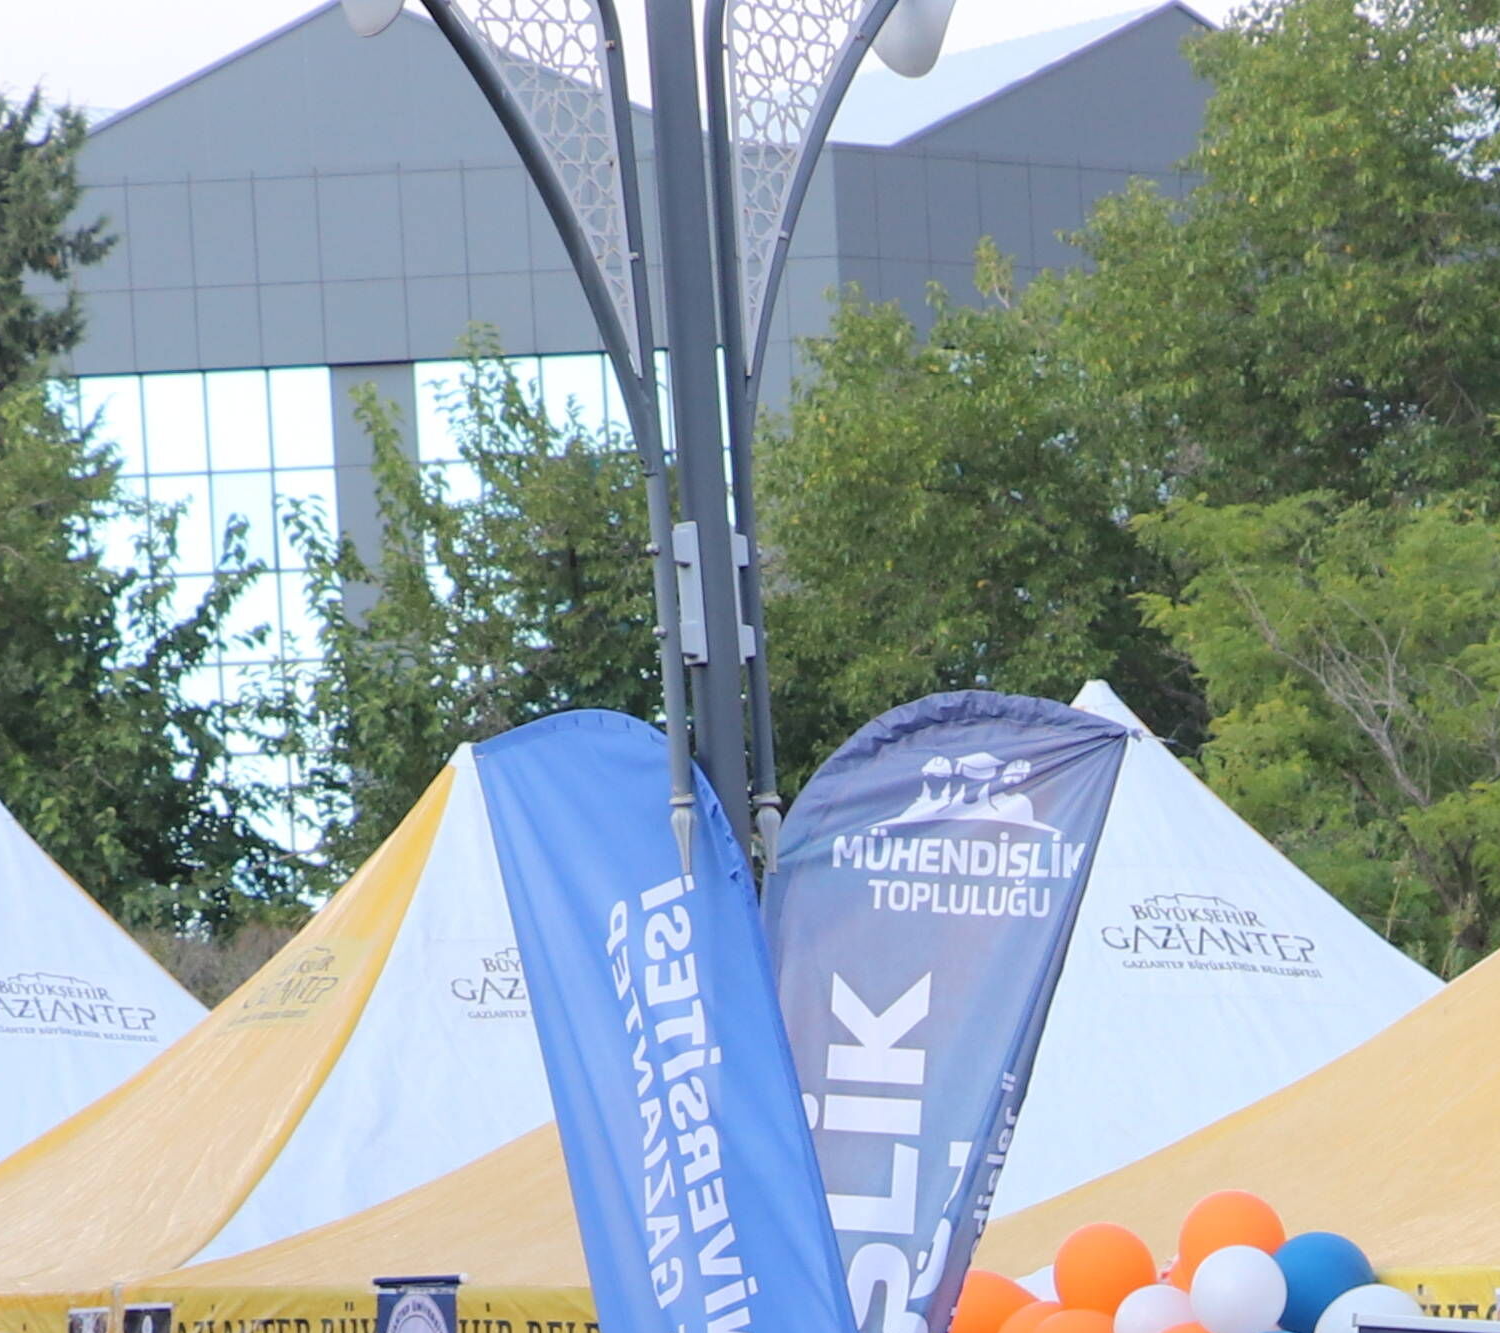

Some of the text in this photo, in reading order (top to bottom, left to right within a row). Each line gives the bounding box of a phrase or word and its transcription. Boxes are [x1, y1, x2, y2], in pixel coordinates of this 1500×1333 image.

[832, 828, 1086, 880] MÜHENDİSLİK
[868, 879, 1050, 918] TOPLULUĞU
[1101, 923, 1316, 963] GAZİANTEP
